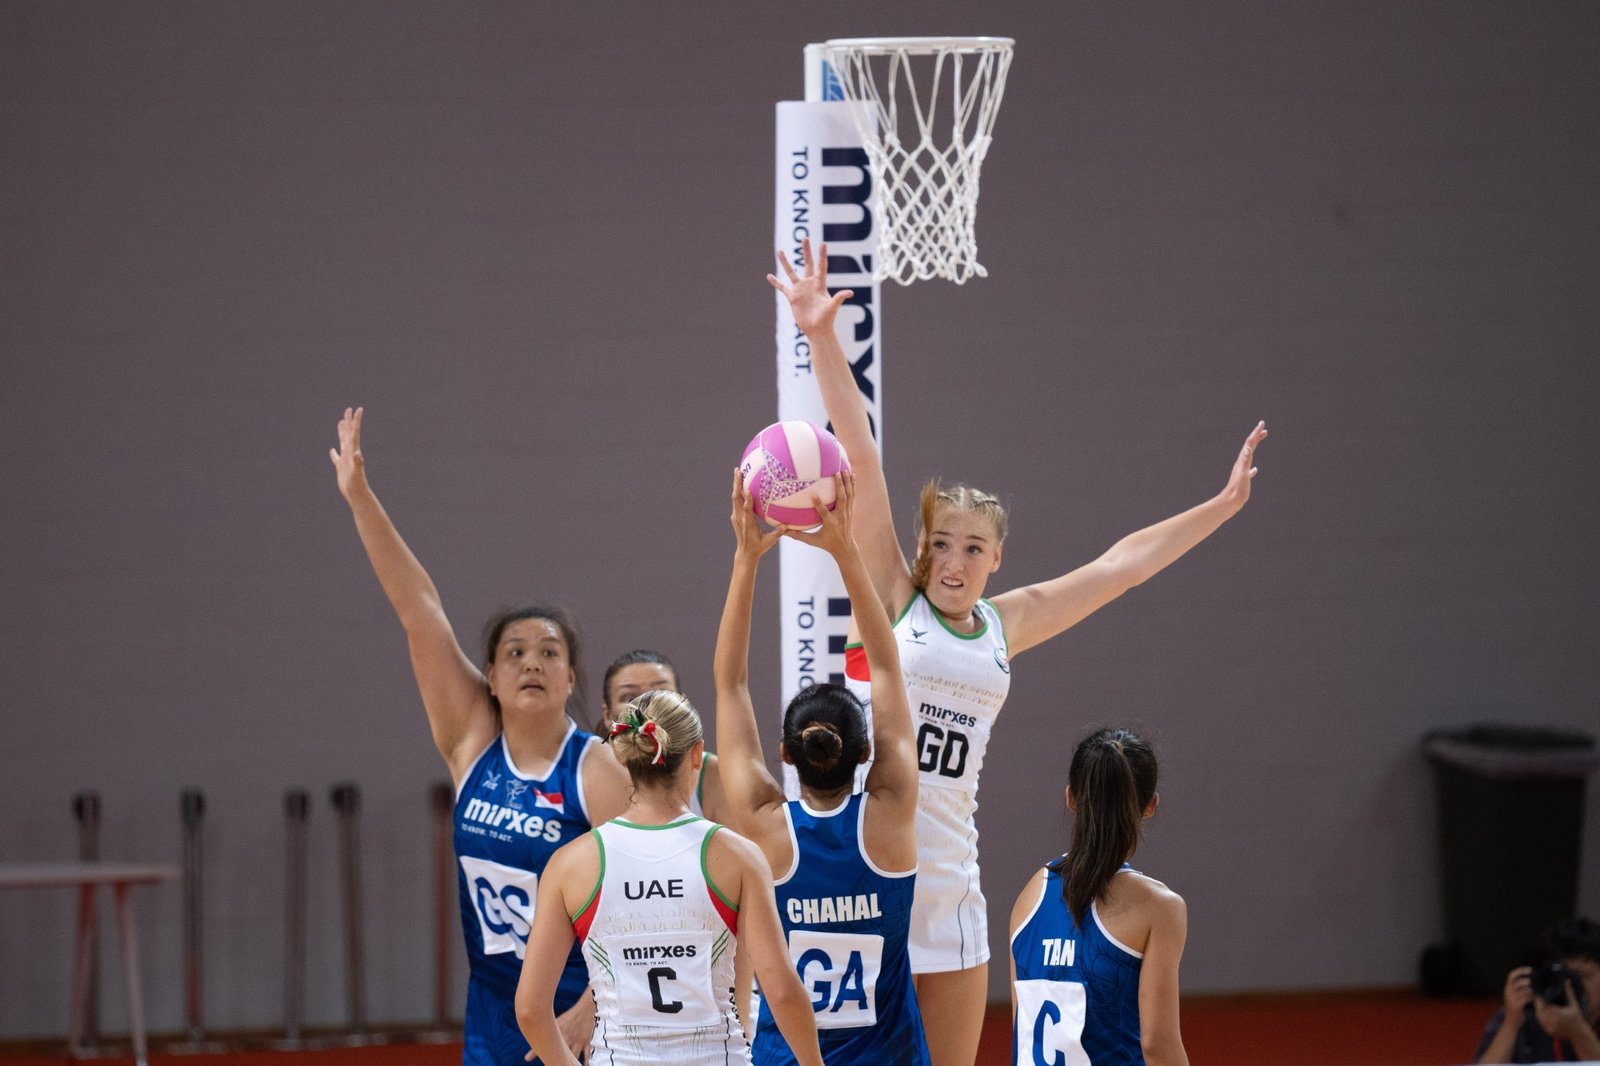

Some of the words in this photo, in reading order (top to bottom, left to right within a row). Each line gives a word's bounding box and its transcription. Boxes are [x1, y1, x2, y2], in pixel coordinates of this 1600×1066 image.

[792, 146, 808, 180] TO
[798, 596, 815, 629] TO
[919, 702, 977, 728] mirxes
[917, 722, 969, 779] GD
[464, 797, 562, 843] mirxes
[624, 879, 684, 900] UAE
[787, 893, 882, 924] CHAHAL
[622, 945, 697, 960] mirxes
[1042, 938, 1076, 967] TAN
[647, 967, 684, 1014] C
[796, 948, 869, 1013] GA
[1032, 1000, 1066, 1066] C
